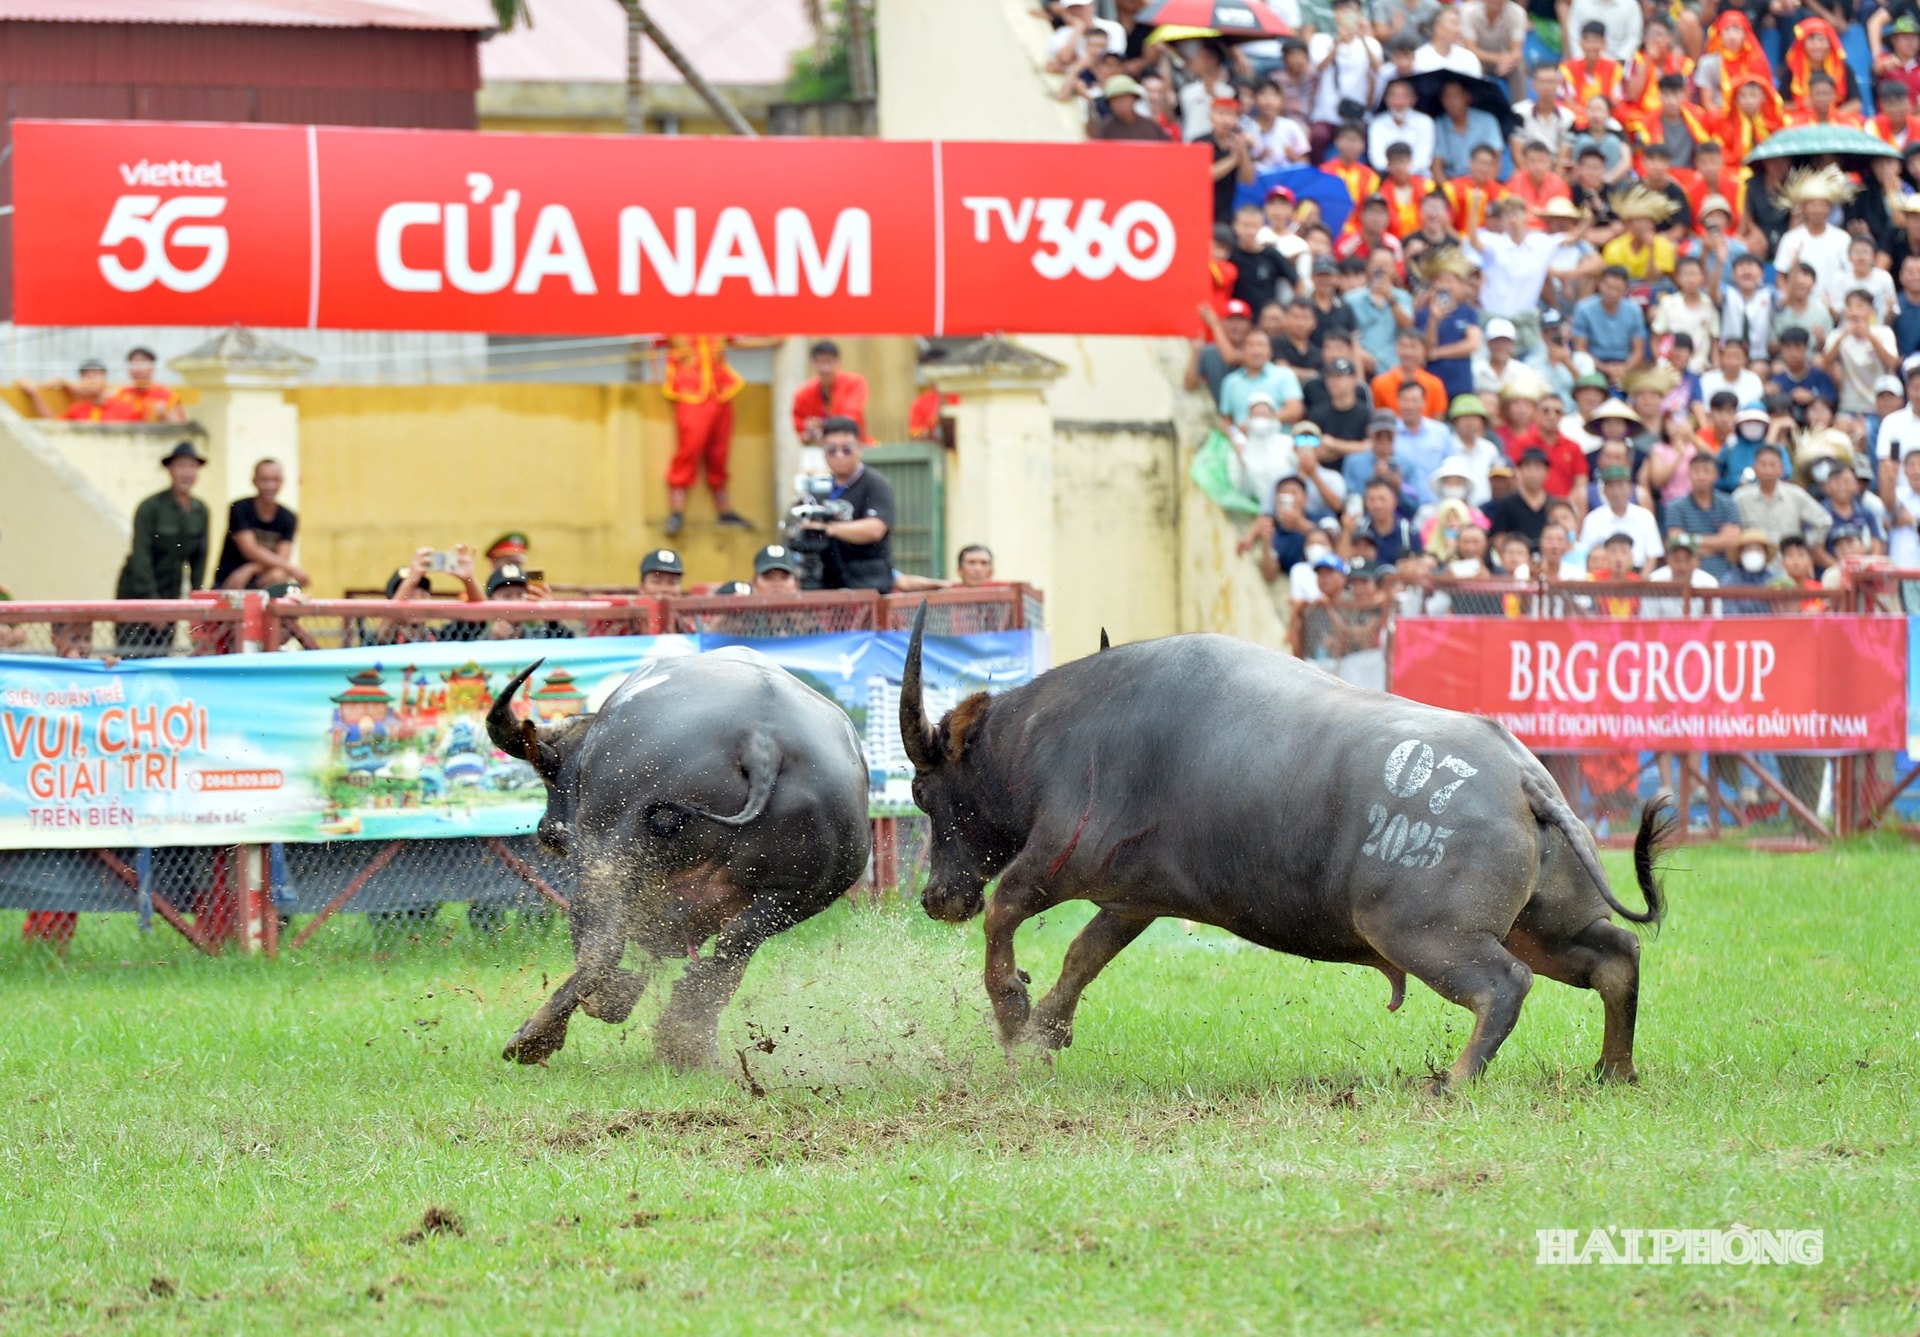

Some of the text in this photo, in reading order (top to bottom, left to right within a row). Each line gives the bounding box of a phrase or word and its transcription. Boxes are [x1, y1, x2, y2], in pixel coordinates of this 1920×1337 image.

[119, 158, 227, 188] viettel
[97, 195, 229, 292] 5G
[376, 172, 872, 297] CỬA NAM
[962, 196, 1177, 281] TV360
[1508, 640, 1775, 703] BRG GROUP
[4, 700, 208, 759] VUI CHƠI
[1558, 713, 1596, 740] DỊCH
[1648, 709, 1705, 737] NGÀNH
[1708, 709, 1754, 737] HÀNG
[1792, 709, 1828, 741] VIỆT
[1830, 713, 1868, 737] NAM
[30, 745, 180, 799] GIẢI TRÍ
[1383, 739, 1479, 815] 07
[30, 802, 81, 827] TRÊN
[89, 796, 135, 826] BIỂN
[1361, 803, 1456, 869] 2025
